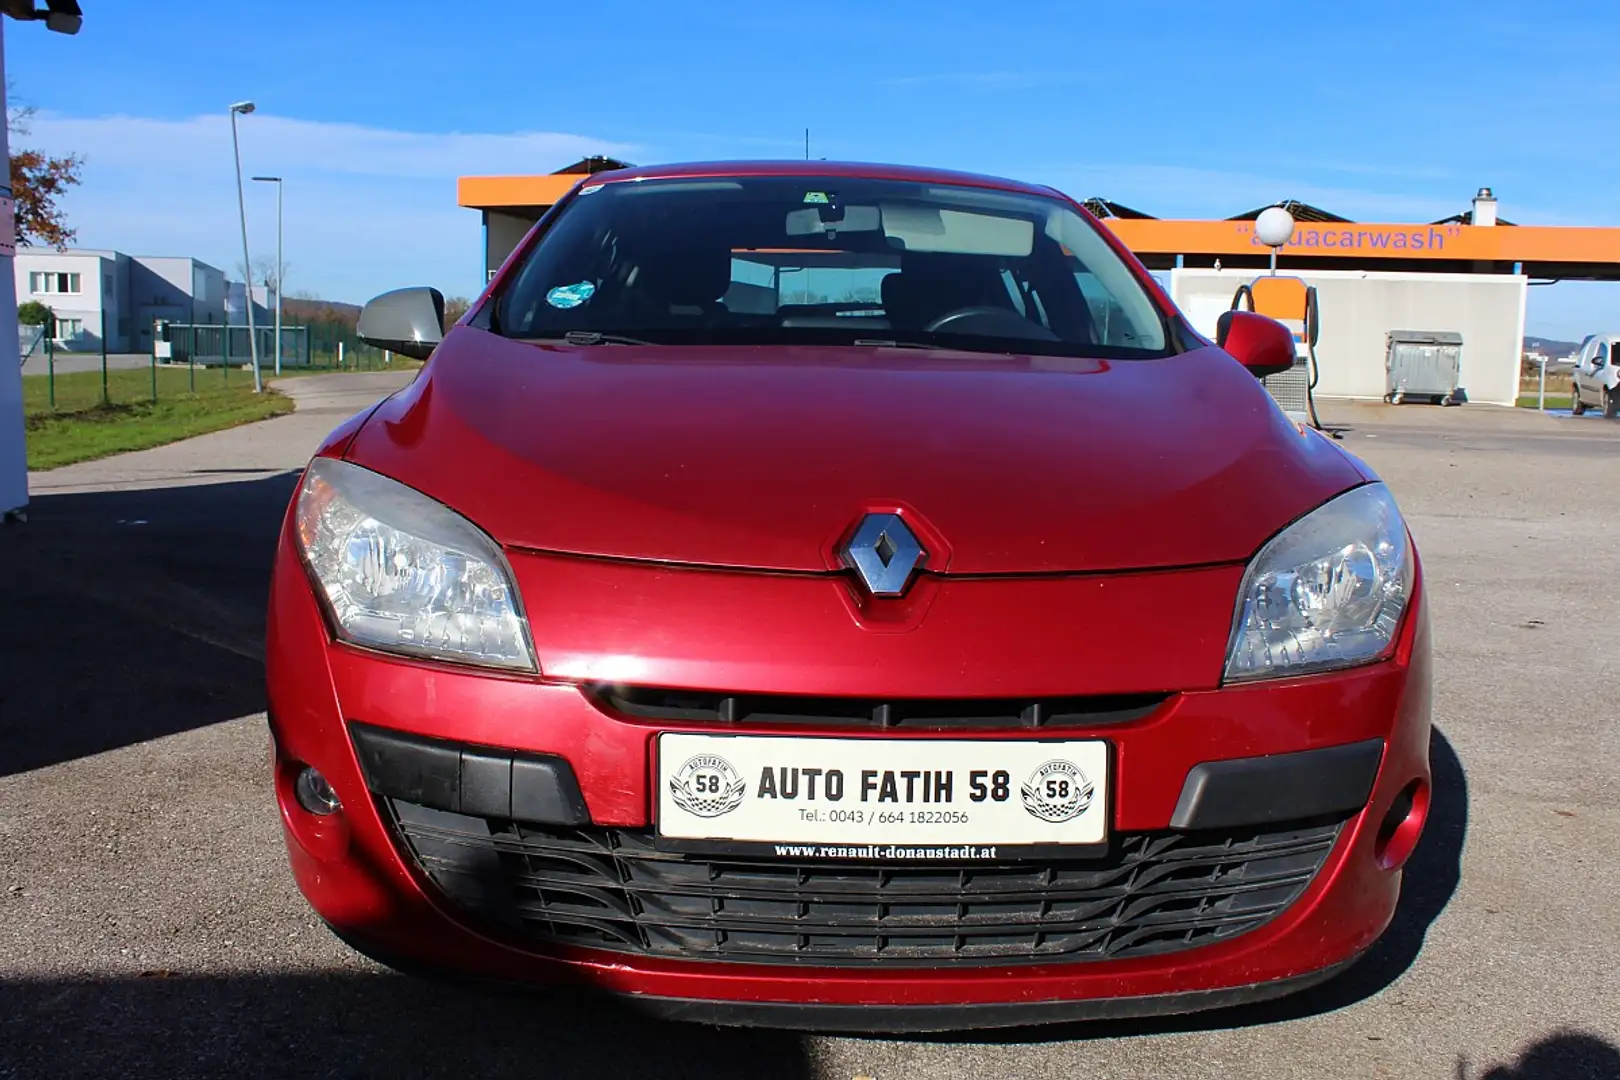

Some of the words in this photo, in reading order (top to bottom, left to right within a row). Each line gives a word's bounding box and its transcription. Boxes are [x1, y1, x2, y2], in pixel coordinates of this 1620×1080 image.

[696, 774, 720, 793] 58
[757, 766, 844, 801] AUTO
[860, 769, 953, 803] FATIH
[969, 769, 1010, 802] 58
[1046, 780, 1069, 798] 58
[798, 808, 826, 822] Tel.:
[829, 809, 864, 823] 0043
[868, 811, 875, 826] /
[878, 811, 904, 824] 664
[909, 811, 969, 824] 1822056
[774, 844, 997, 859] www.renault-donaustadt.at
